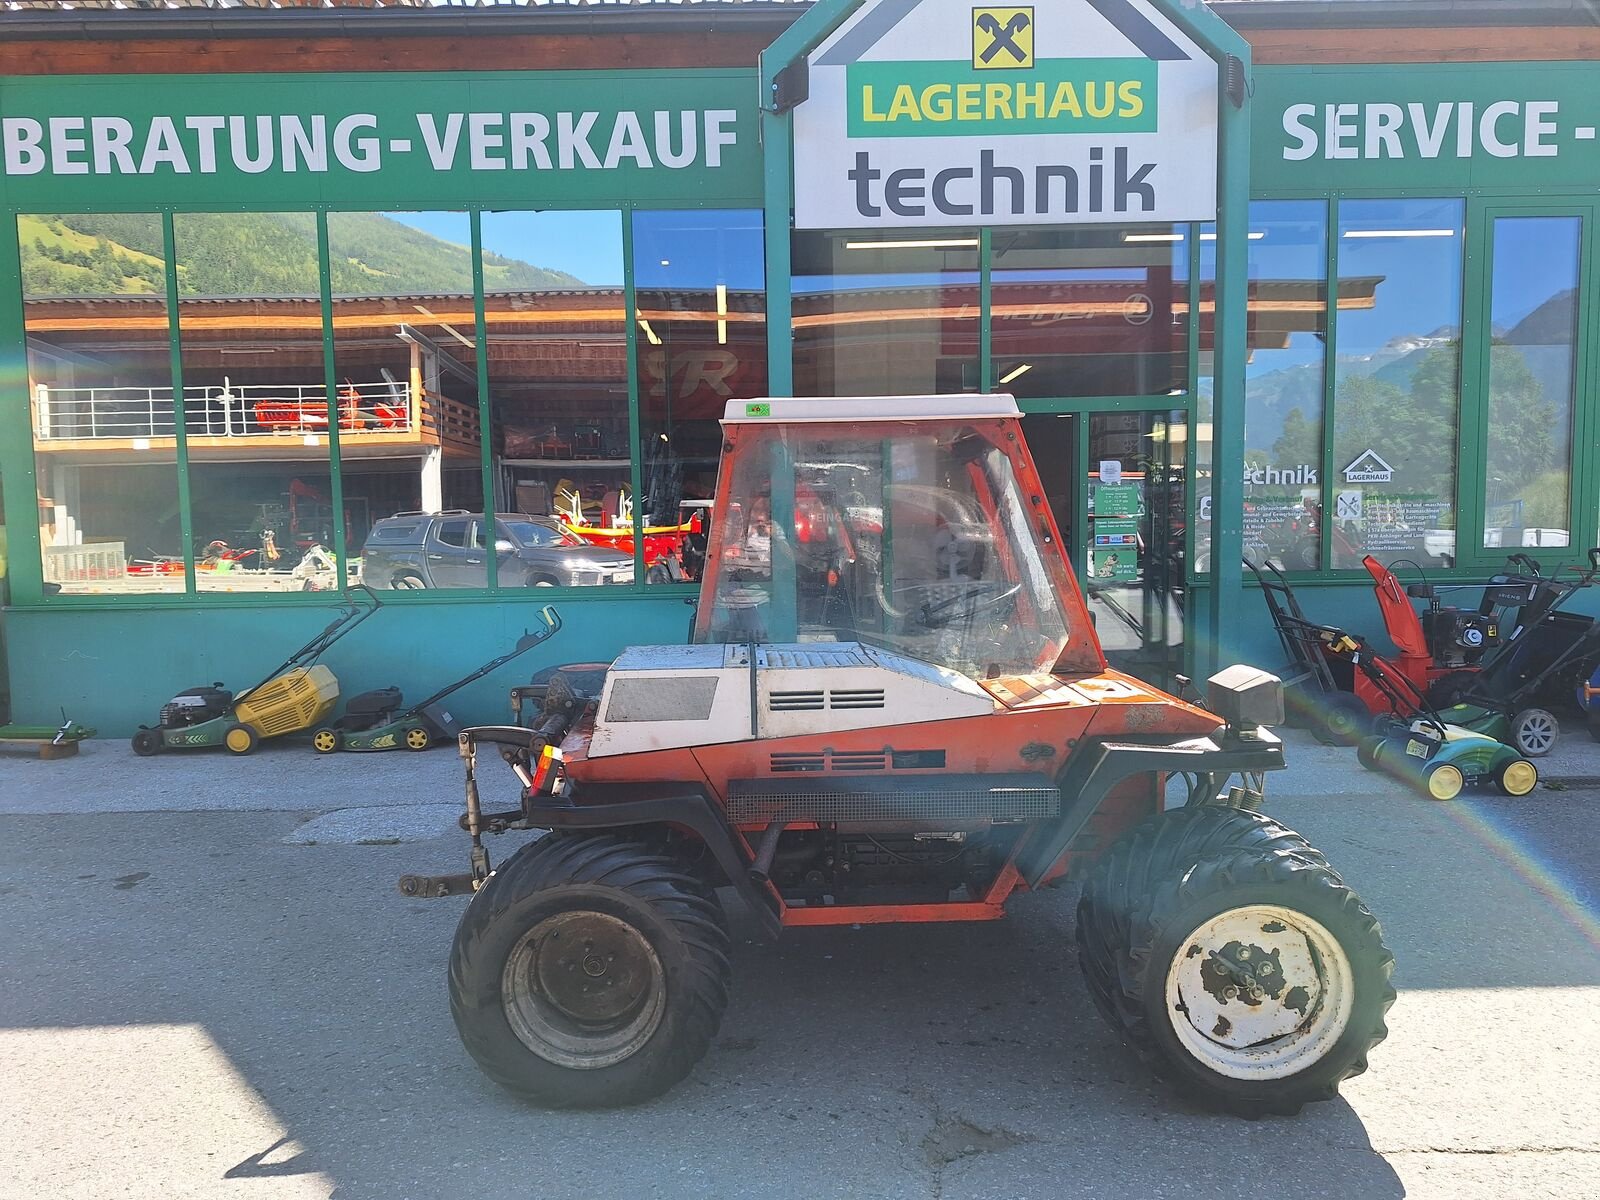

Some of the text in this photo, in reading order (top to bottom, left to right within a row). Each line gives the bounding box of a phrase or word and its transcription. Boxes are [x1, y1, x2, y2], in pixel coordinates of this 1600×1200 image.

[862, 80, 1144, 122] LAGERHAUS
[3, 109, 738, 176] BERATUNG-VERKAUF
[1282, 100, 1559, 161] SERVICE
[848, 146, 1158, 217] technik
[1243, 465, 1317, 485] echnik
[1348, 473, 1389, 481] LAGERHAUS
